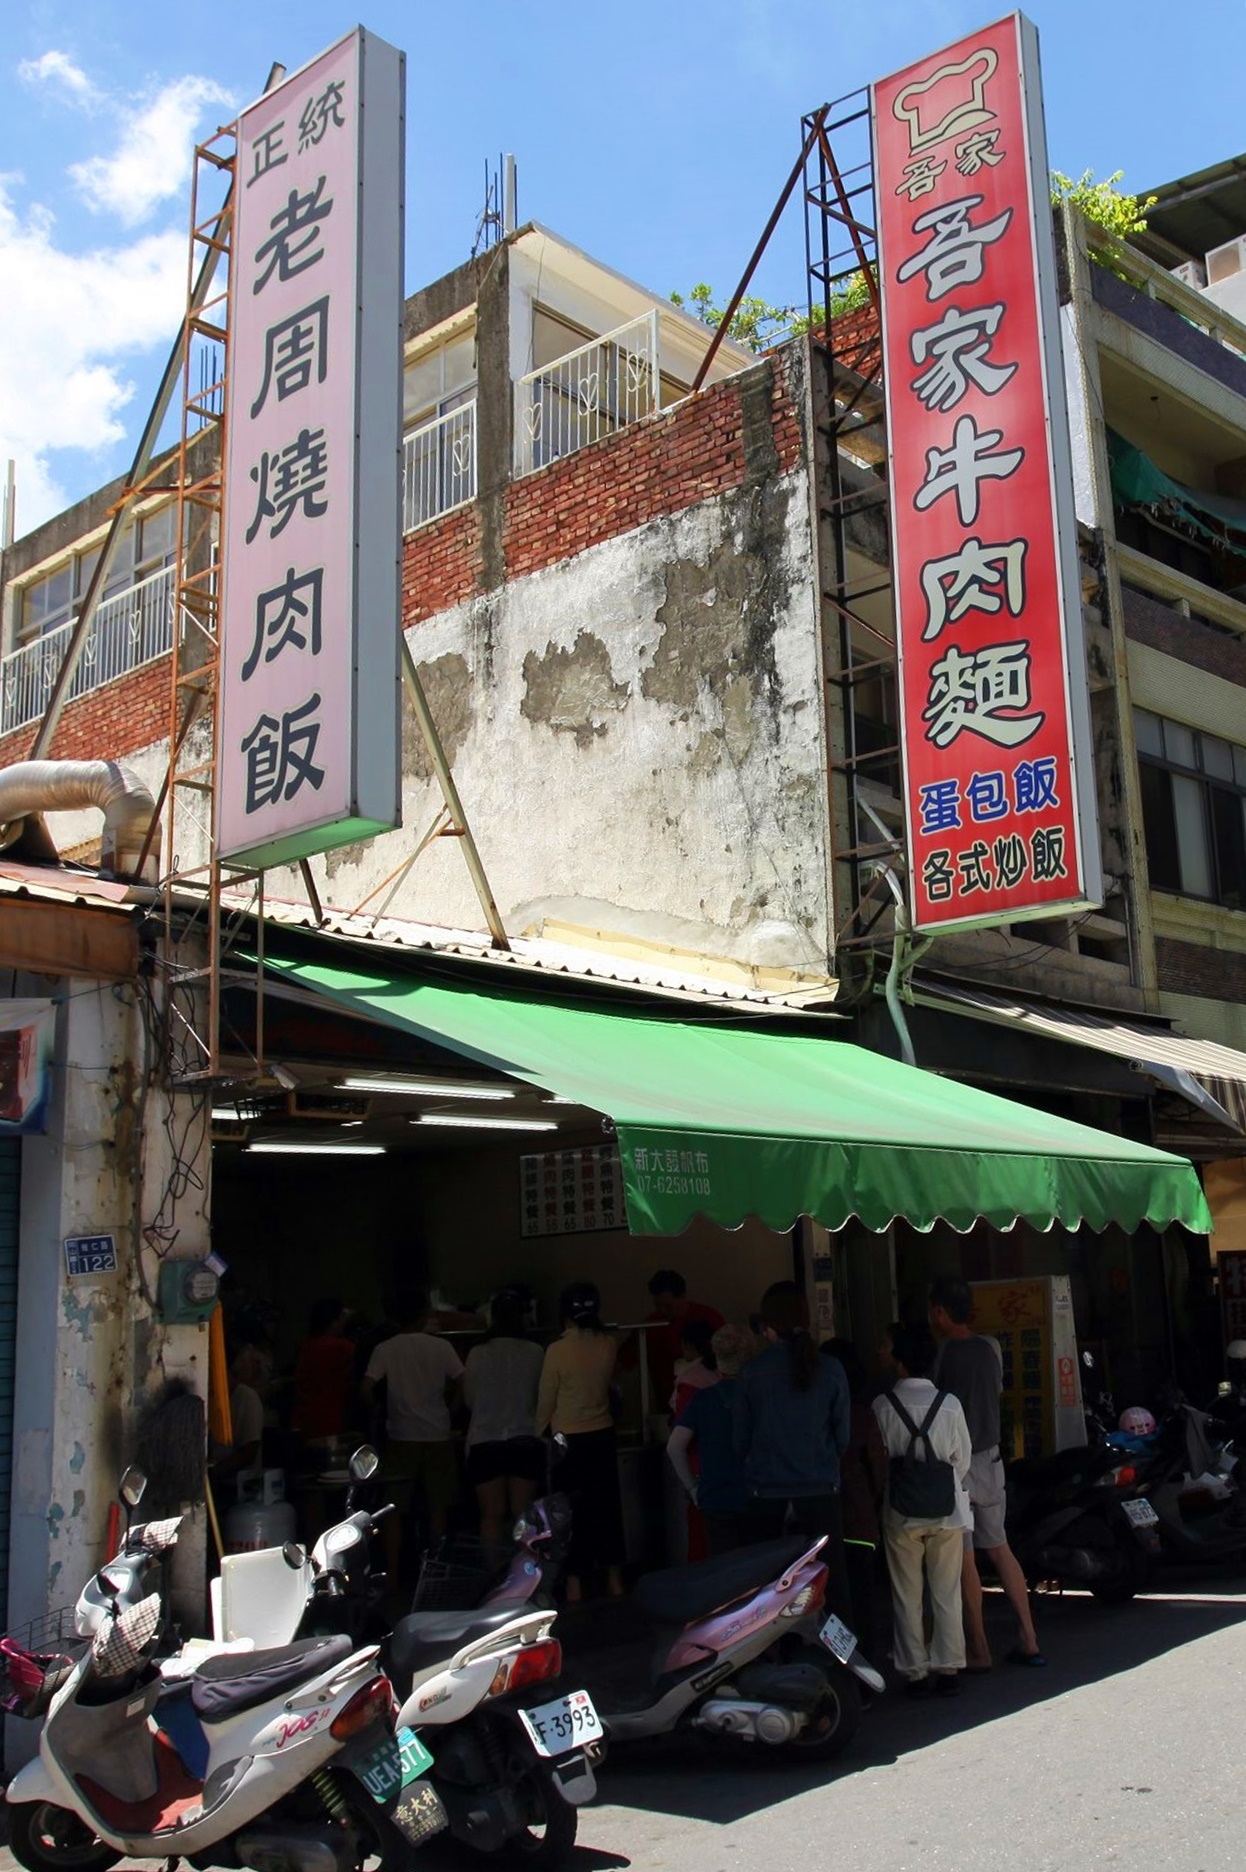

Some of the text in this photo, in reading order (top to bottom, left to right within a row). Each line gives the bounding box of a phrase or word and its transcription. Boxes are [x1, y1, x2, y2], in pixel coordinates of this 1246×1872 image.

[246, 80, 346, 189] 正統
[895, 128, 1007, 203] 吾家
[241, 174, 334, 815] 老周燒肉飯
[896, 194, 1046, 750] 吾家牛肉麵
[919, 756, 1060, 835] 蛋包飯
[922, 826, 1067, 902] 各式炒飯
[637, 1175, 711, 1196] 07-6258108
[82, 1255, 114, 1272] 122
